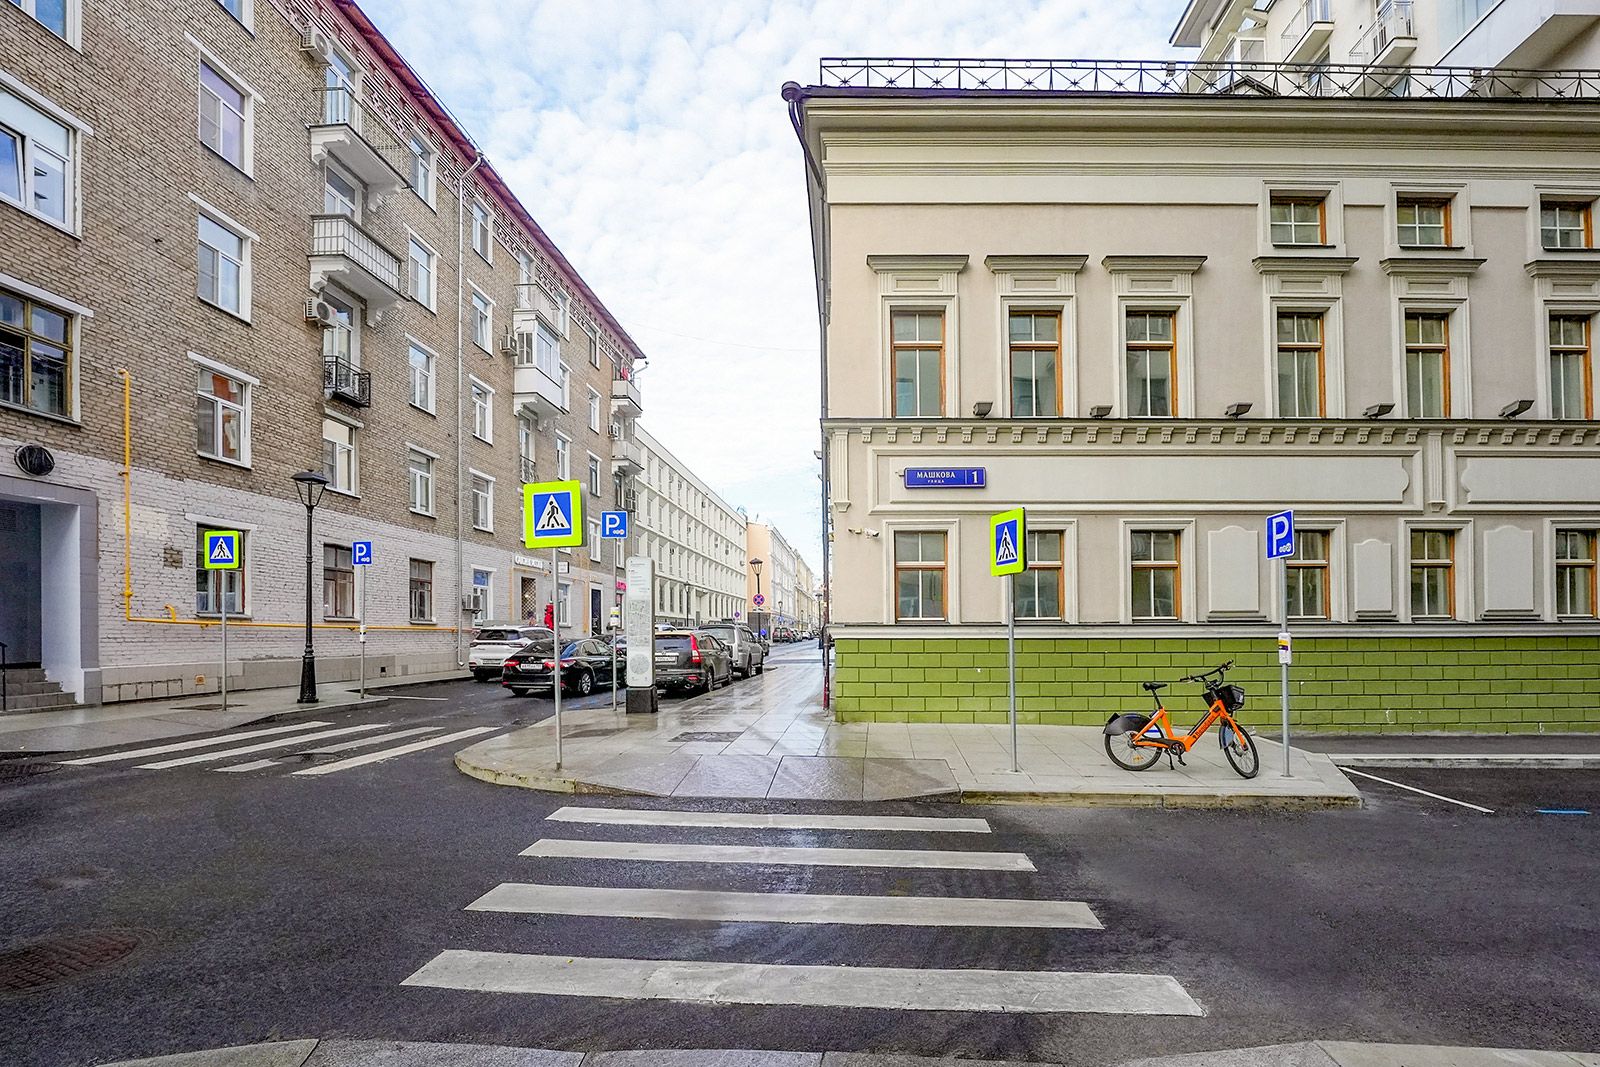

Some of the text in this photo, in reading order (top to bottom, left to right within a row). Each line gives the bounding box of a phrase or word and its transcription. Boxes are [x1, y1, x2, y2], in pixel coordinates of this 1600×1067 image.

[971, 471, 978, 484] 1
[605, 514, 621, 535] P
[1272, 515, 1290, 556] P
[355, 543, 367, 563] P
